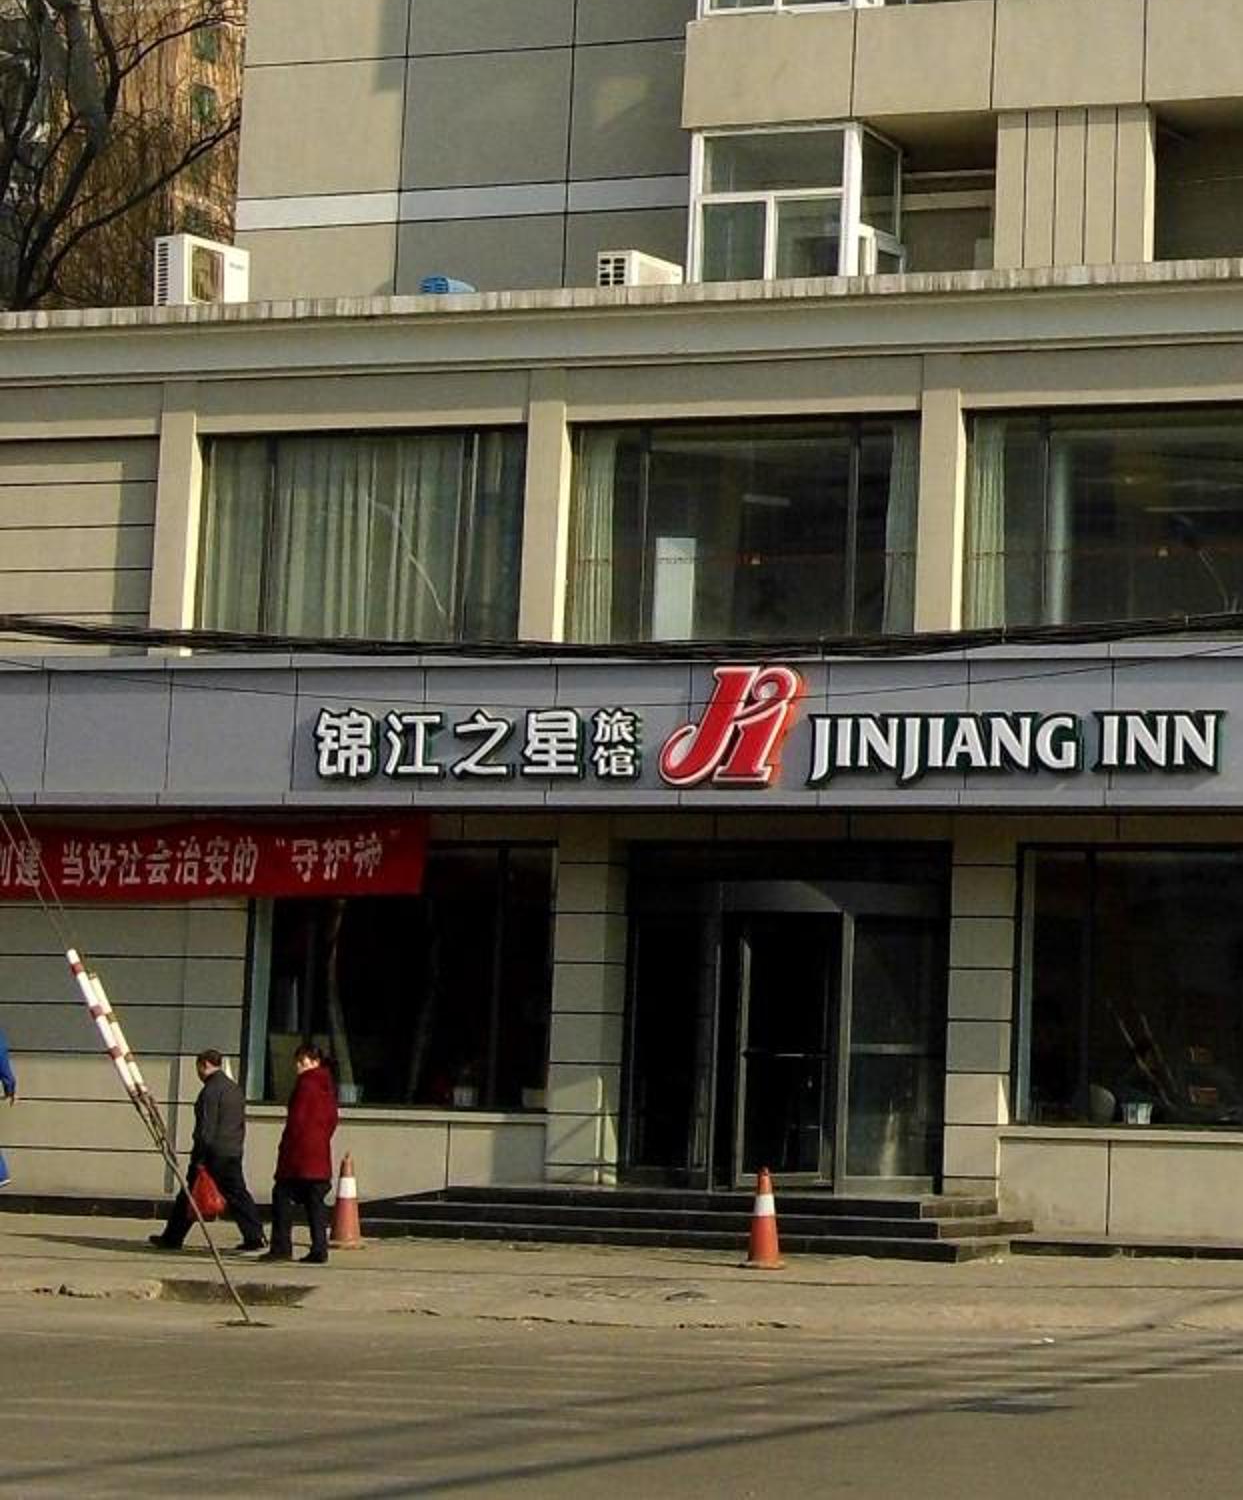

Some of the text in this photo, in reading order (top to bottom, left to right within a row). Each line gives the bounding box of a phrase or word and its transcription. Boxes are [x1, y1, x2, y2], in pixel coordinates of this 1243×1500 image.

[316, 707, 584, 780] 锦江之星
[592, 710, 641, 779] 旅馆
[810, 710, 1229, 789] JINJIANG INN
